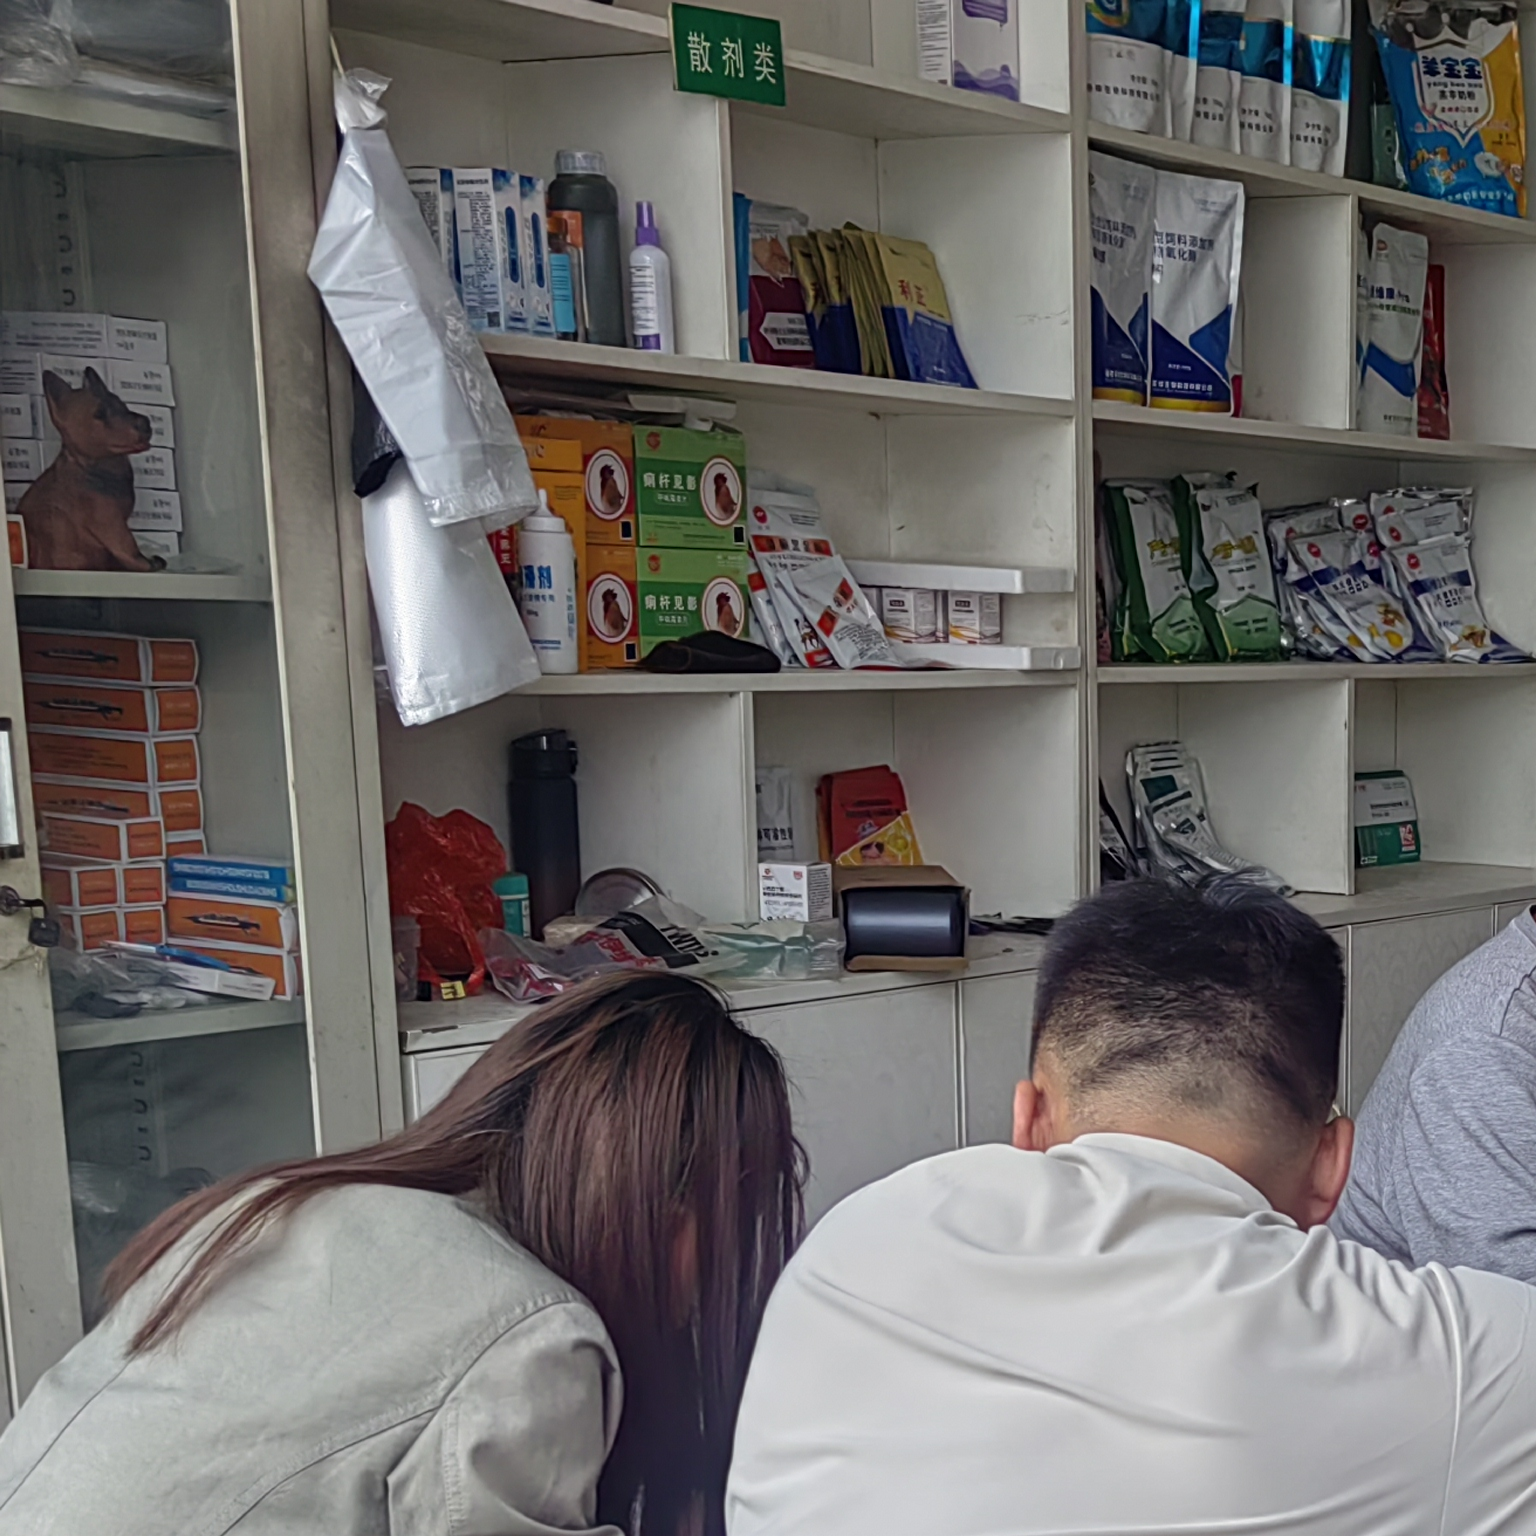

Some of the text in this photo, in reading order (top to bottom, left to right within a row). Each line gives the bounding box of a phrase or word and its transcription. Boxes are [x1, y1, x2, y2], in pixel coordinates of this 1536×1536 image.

[686, 31, 777, 84] 散剂类
[1421, 56, 1483, 79] 羊宝宝
